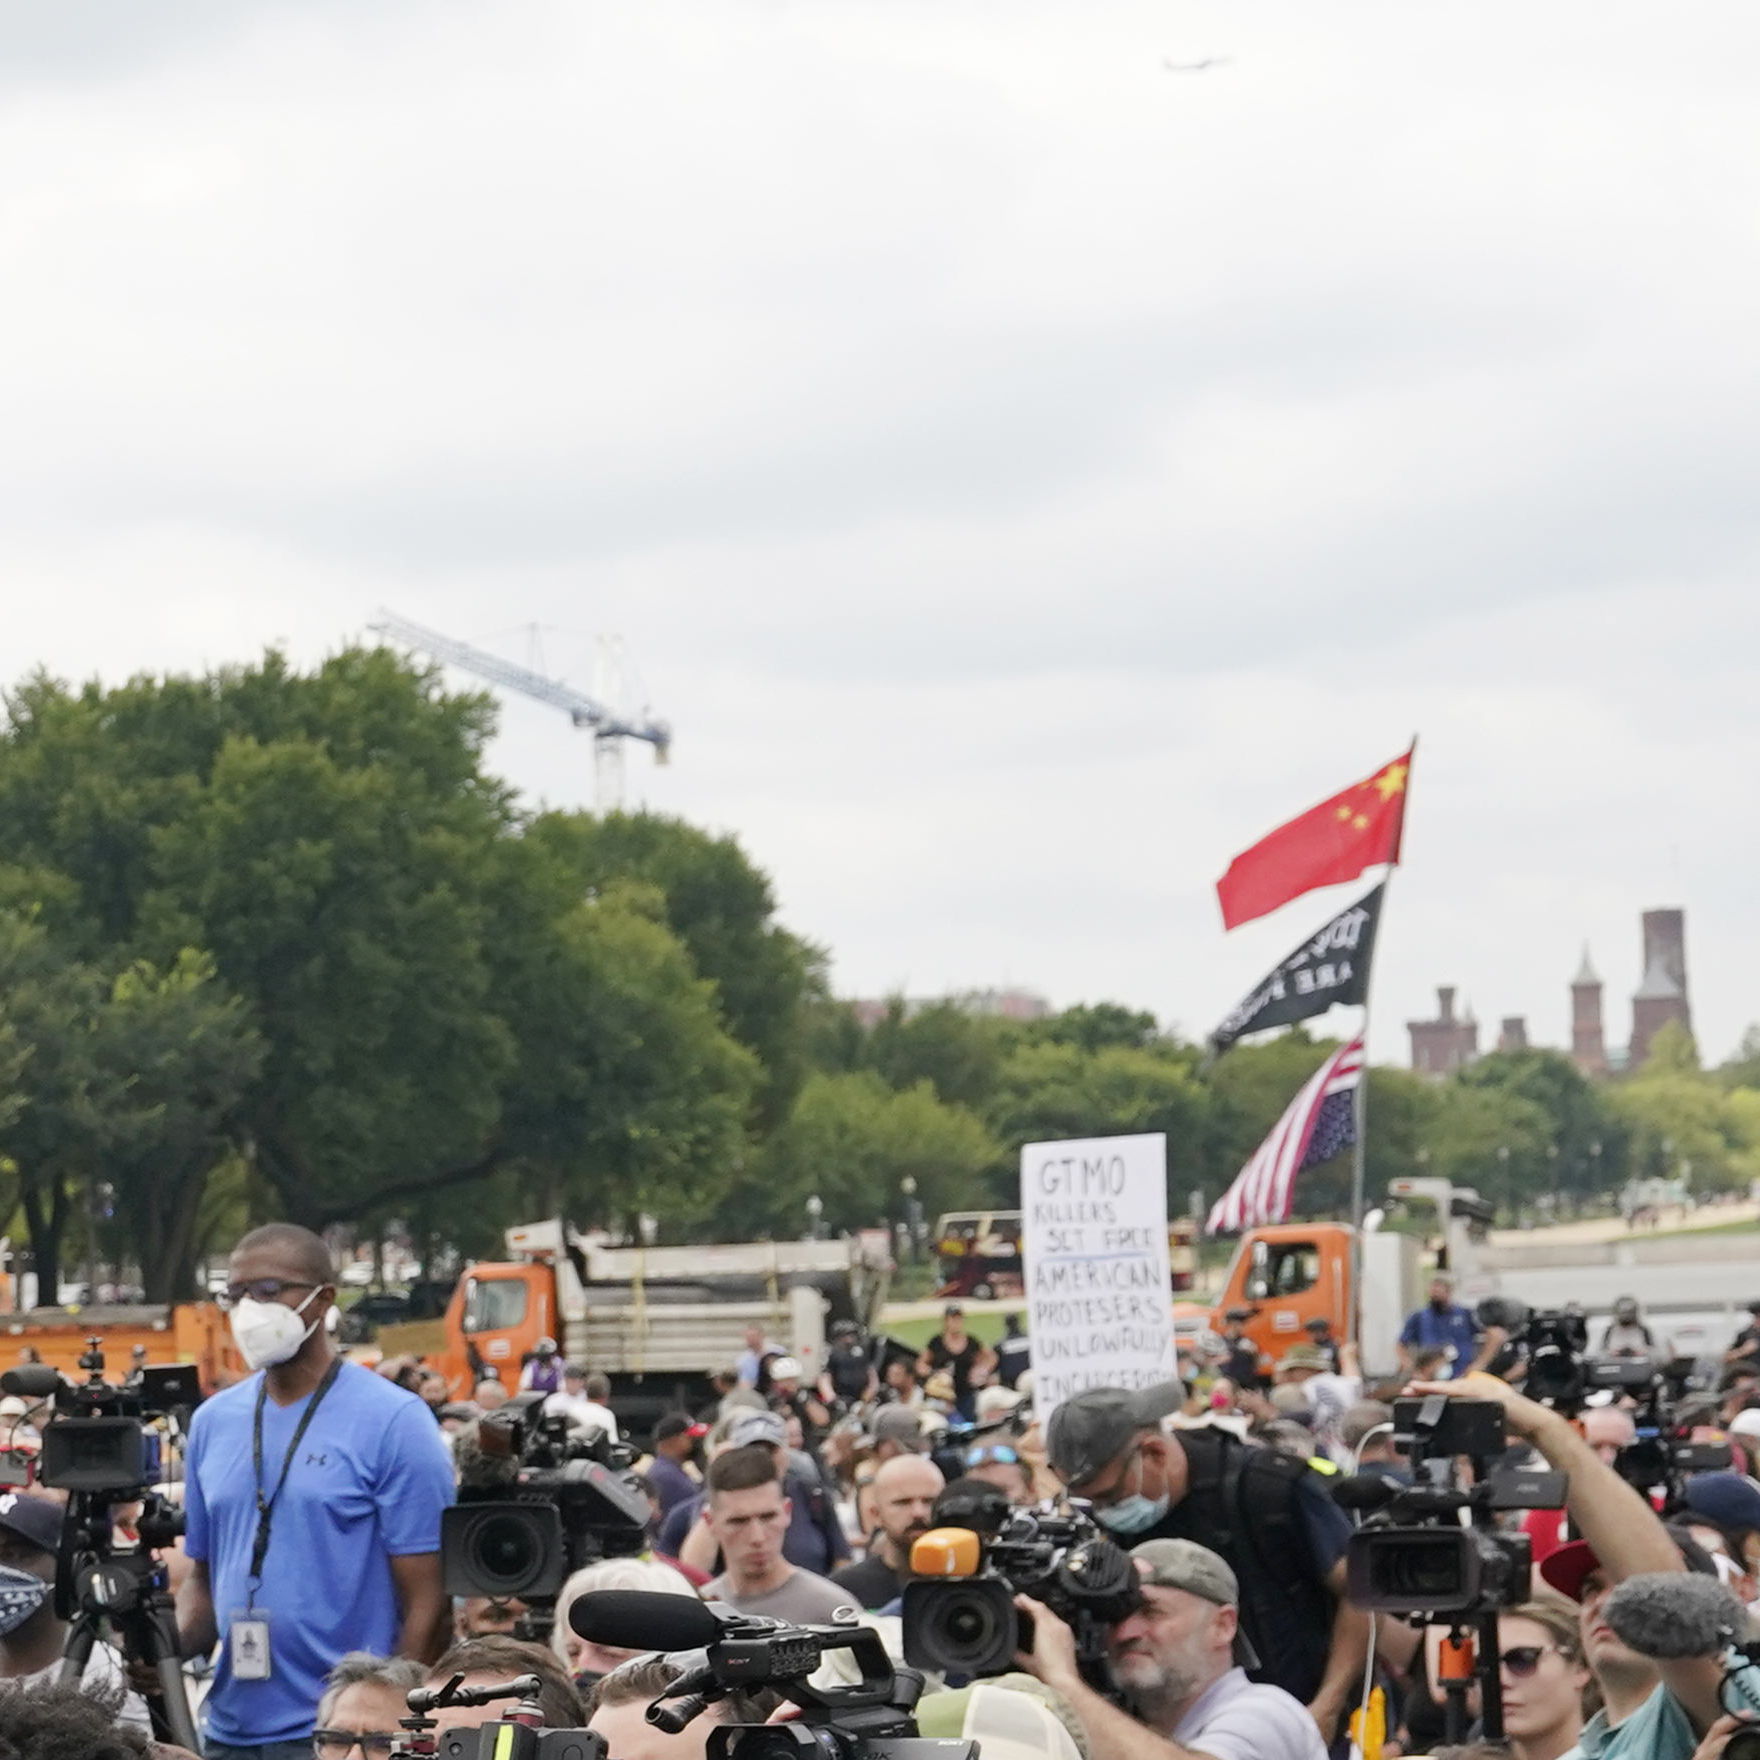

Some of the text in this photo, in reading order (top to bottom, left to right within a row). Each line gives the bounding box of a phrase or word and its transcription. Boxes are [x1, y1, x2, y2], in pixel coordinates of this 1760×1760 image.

[1040, 1156, 1125, 1195] GTMO
[1034, 1203, 1117, 1225] KILLERS
[1047, 1229, 1085, 1252] SET
[1035, 1262, 1161, 1293] AMERICAN
